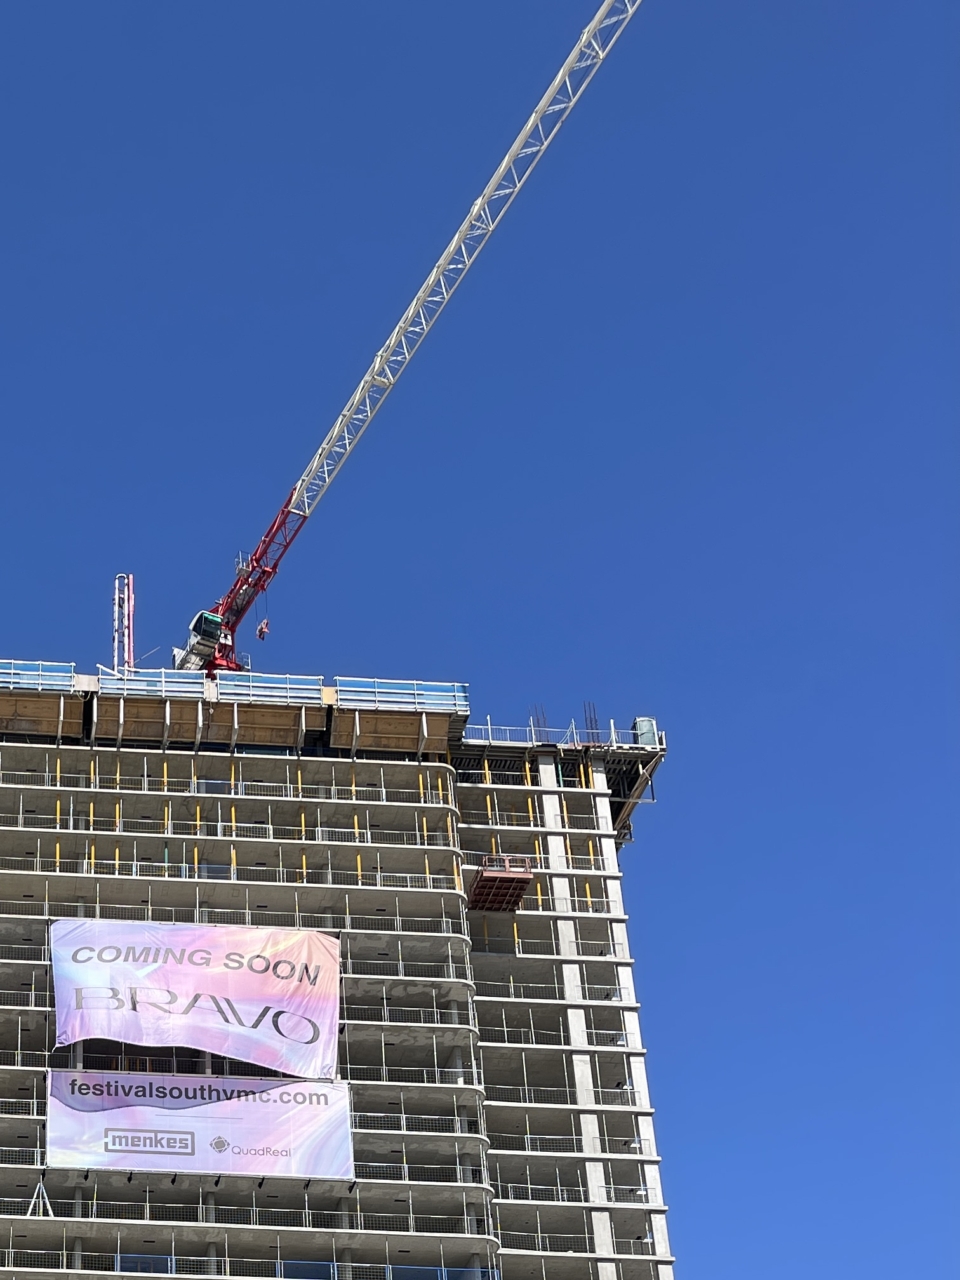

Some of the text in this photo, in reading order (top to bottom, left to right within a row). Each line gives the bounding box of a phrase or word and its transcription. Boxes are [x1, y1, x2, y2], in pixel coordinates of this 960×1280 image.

[71, 945, 321, 986] COMING SOON
[73, 986, 321, 1044] BRAVO
[68, 1078, 329, 1106] festivalsouthvmc.com
[111, 1132, 190, 1150] menkes
[231, 1145, 292, 1157] QuadReal
